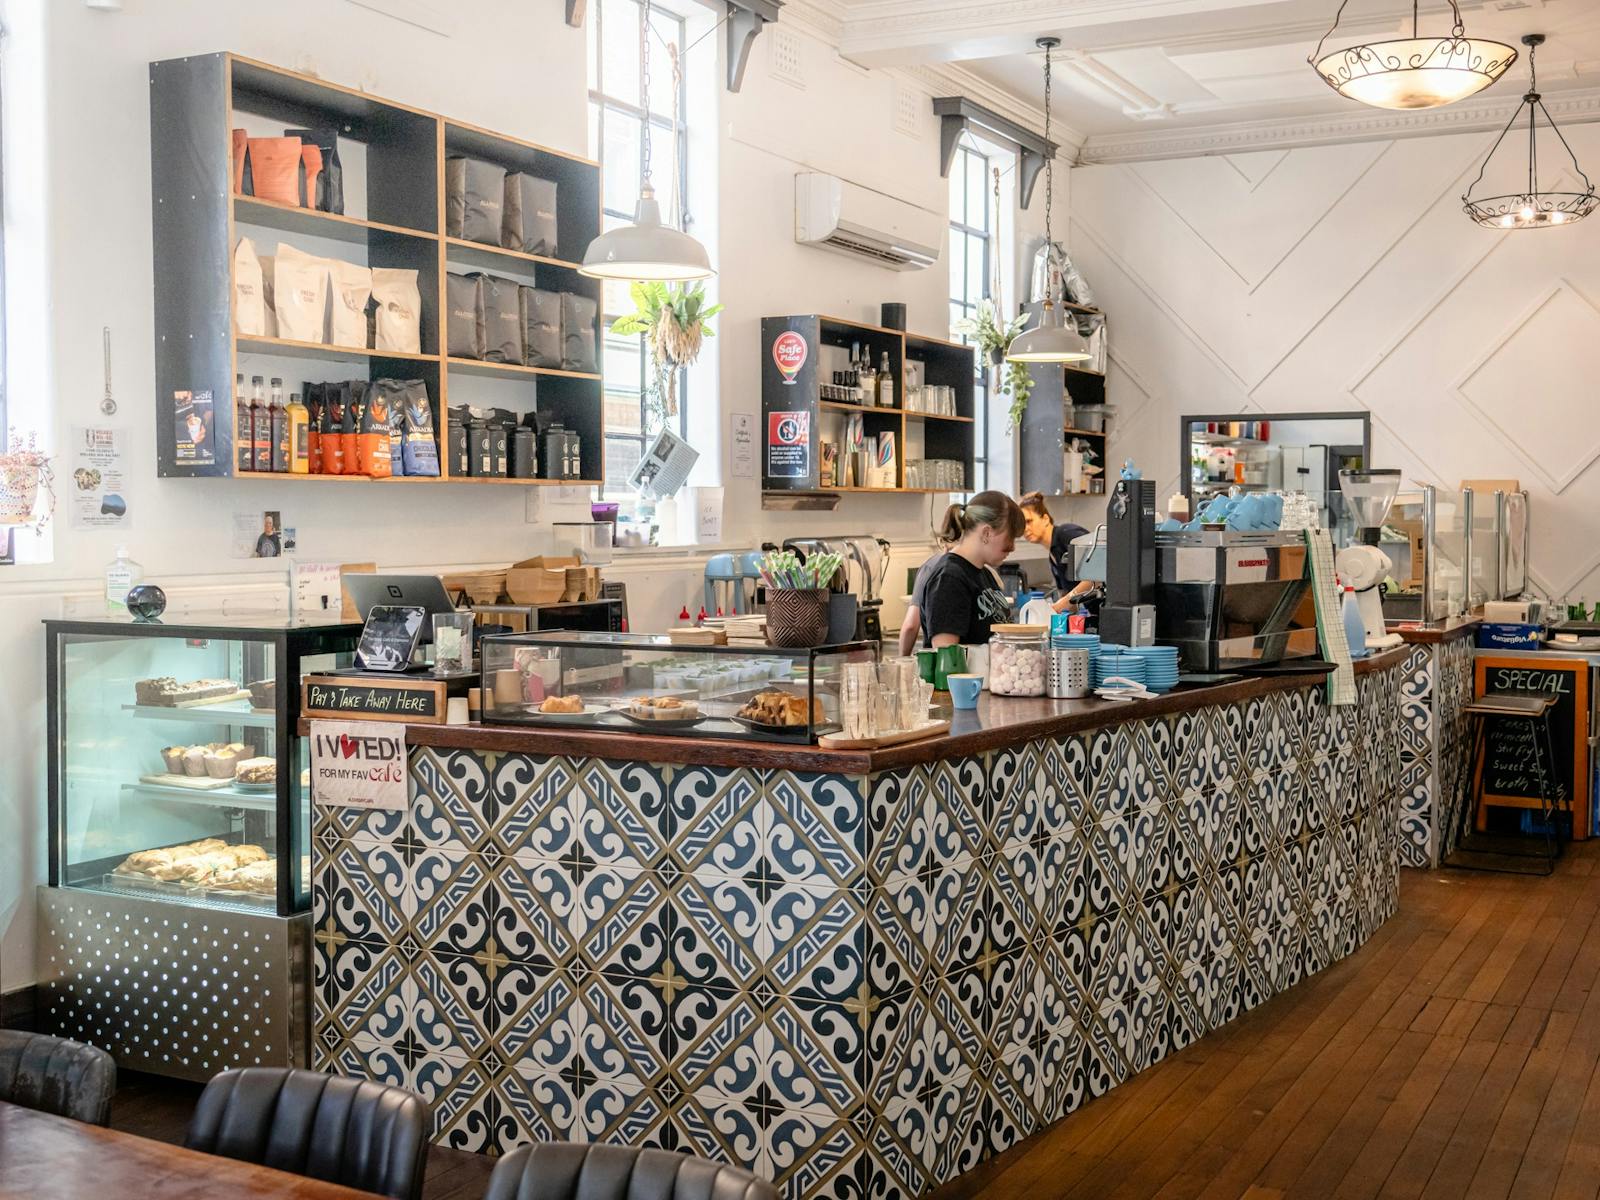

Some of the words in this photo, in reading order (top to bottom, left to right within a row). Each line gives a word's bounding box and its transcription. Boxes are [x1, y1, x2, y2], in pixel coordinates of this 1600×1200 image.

[779, 345, 802, 356] Safe
[1495, 669, 1570, 693] SPECIAL
[310, 686, 327, 706] PAY
[339, 688, 362, 708] TAKE
[365, 689, 391, 710] AWAY
[395, 691, 428, 711] HERE
[316, 734, 323, 758] I
[319, 768, 337, 779] FOR
[338, 769, 351, 779] MY
[352, 769, 369, 780] FAV
[369, 762, 402, 783] café
